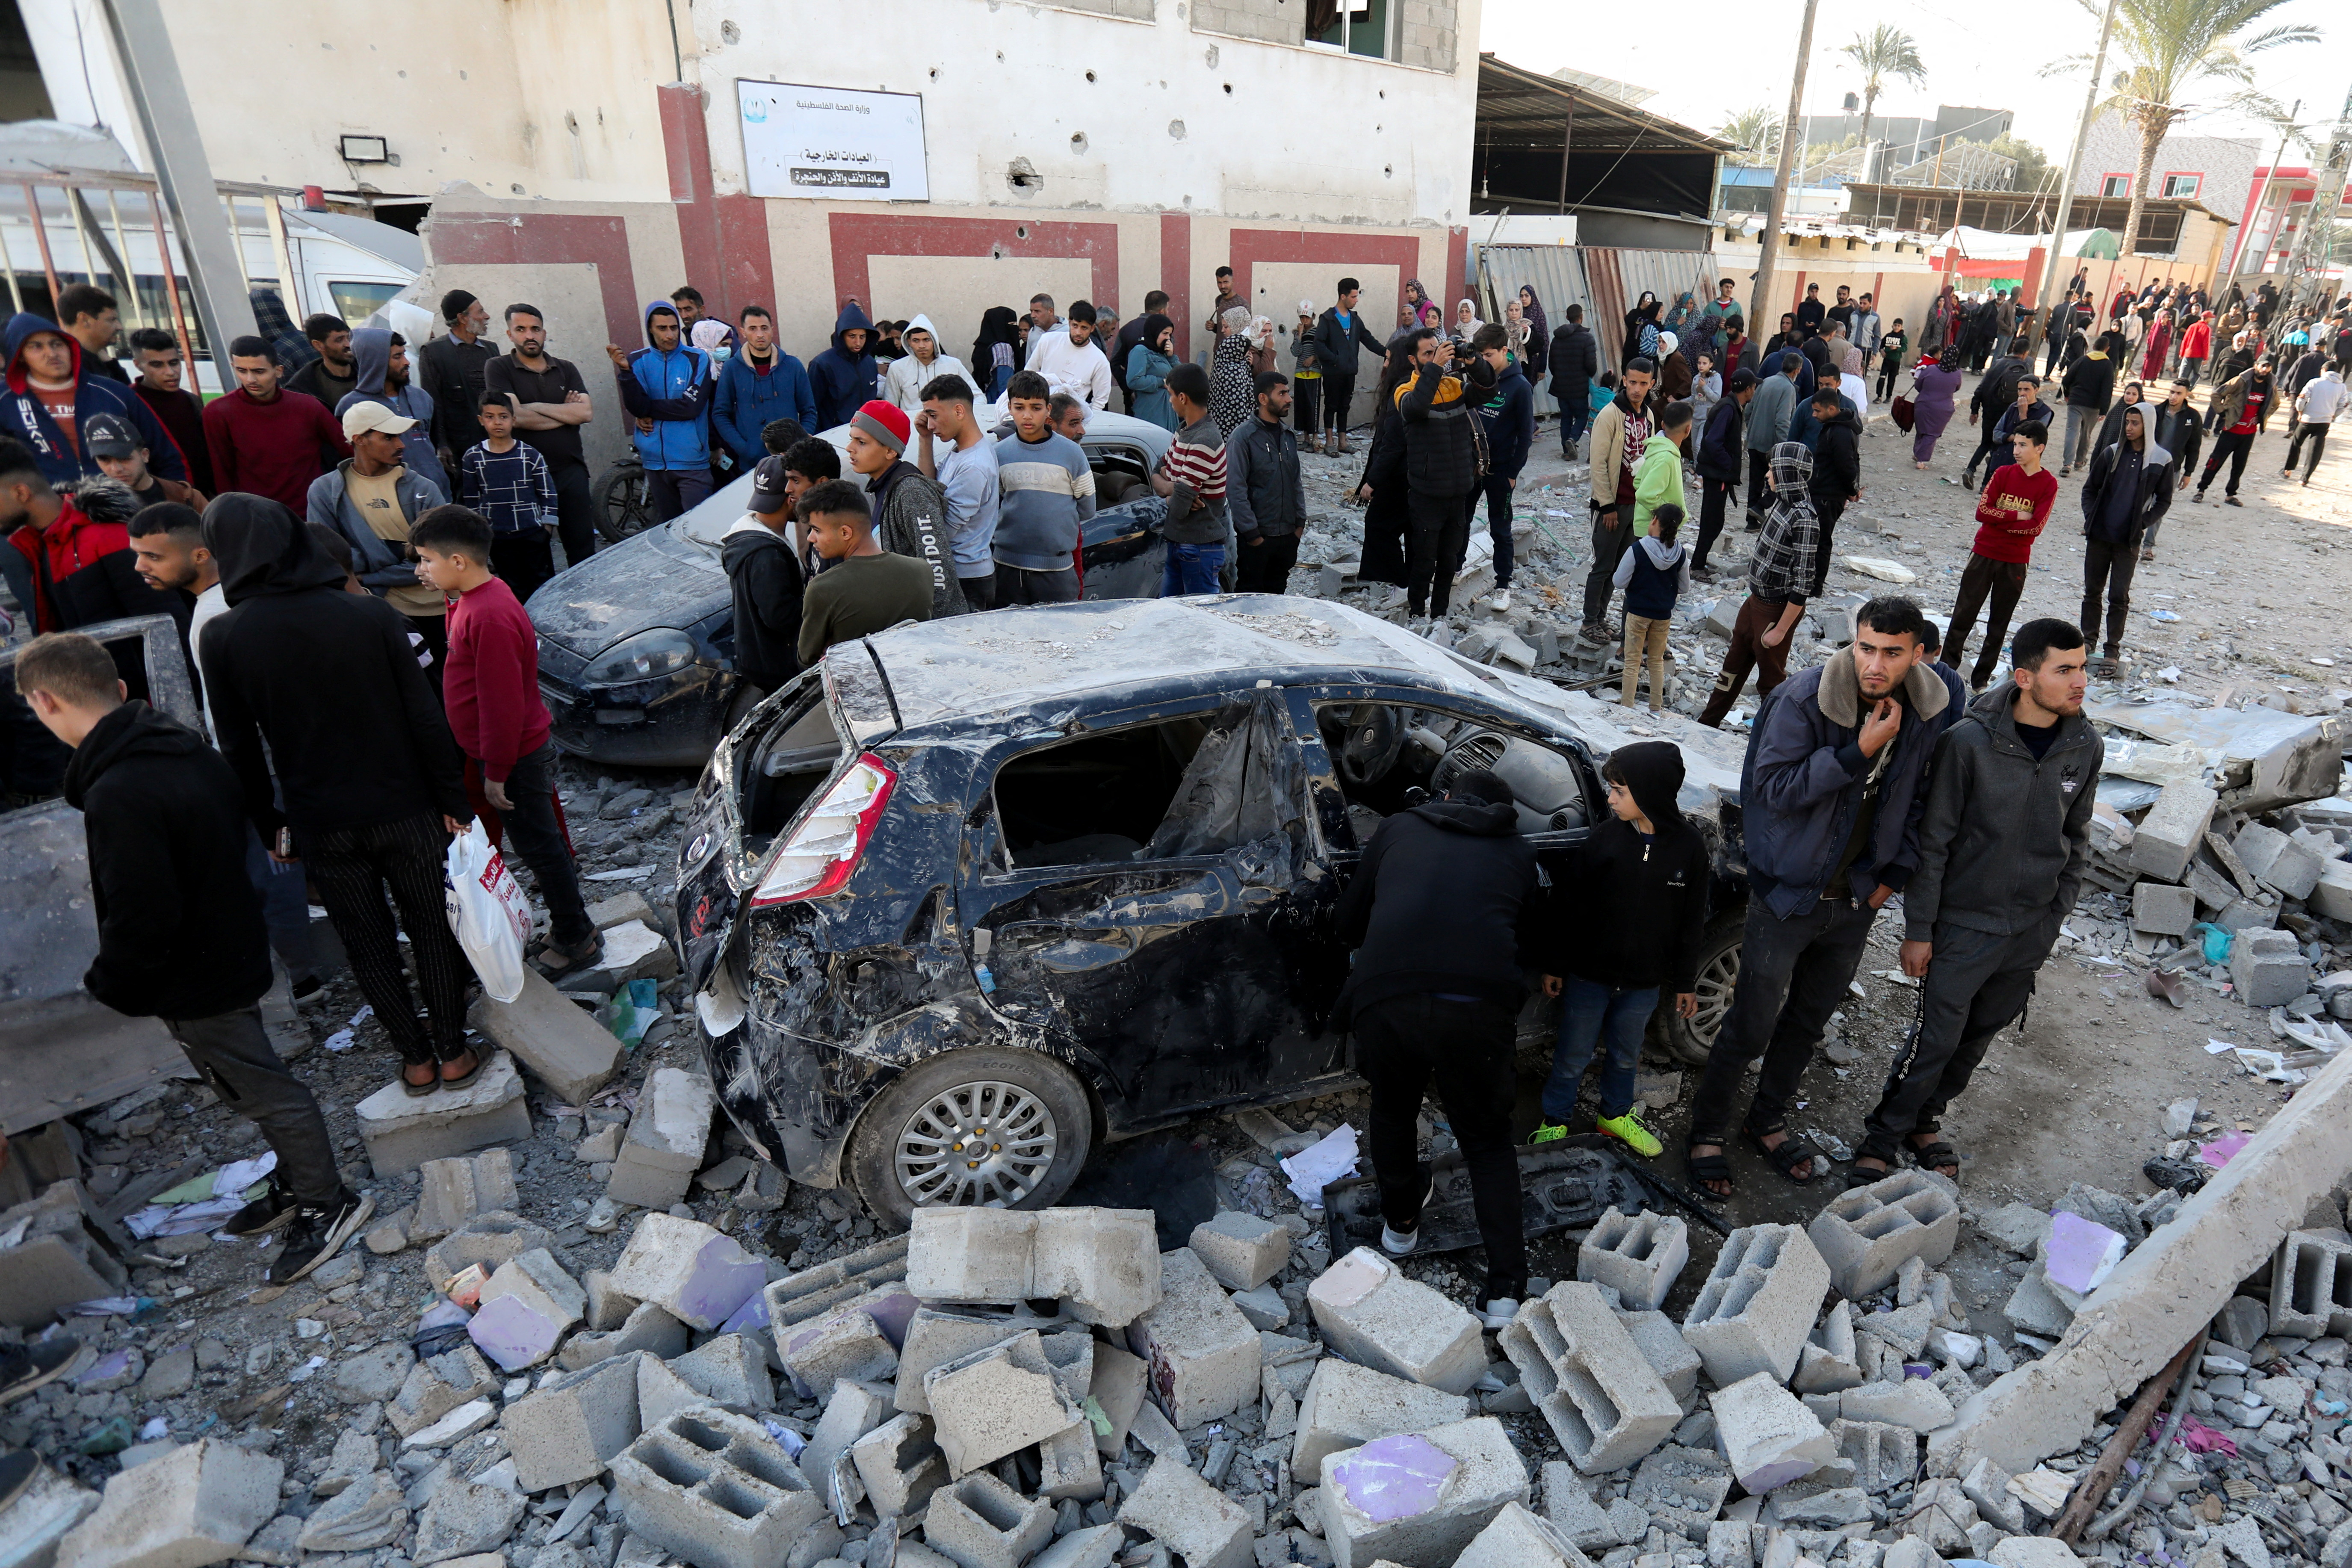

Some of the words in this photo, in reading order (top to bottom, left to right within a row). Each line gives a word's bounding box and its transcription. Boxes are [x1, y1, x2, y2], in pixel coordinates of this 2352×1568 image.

[796, 100, 834, 109] الفلسطينية
[855, 105, 870, 114] وزارة
[804, 149, 840, 163] الخارجية
[841, 151, 872, 164] العيادات
[795, 171, 826, 184] والحنجرة
[827, 171, 847, 184] والأذن
[848, 171, 866, 183] الأنف
[867, 174, 885, 186] عيادة
[1005, 469, 1060, 487] REPLAY
[916, 514, 933, 531] IT.
[921, 534, 940, 556] DO
[926, 558, 946, 591] JUST
[1909, 1051, 1916, 1060] IS
[983, 1062, 1037, 1078] ECOTECH
